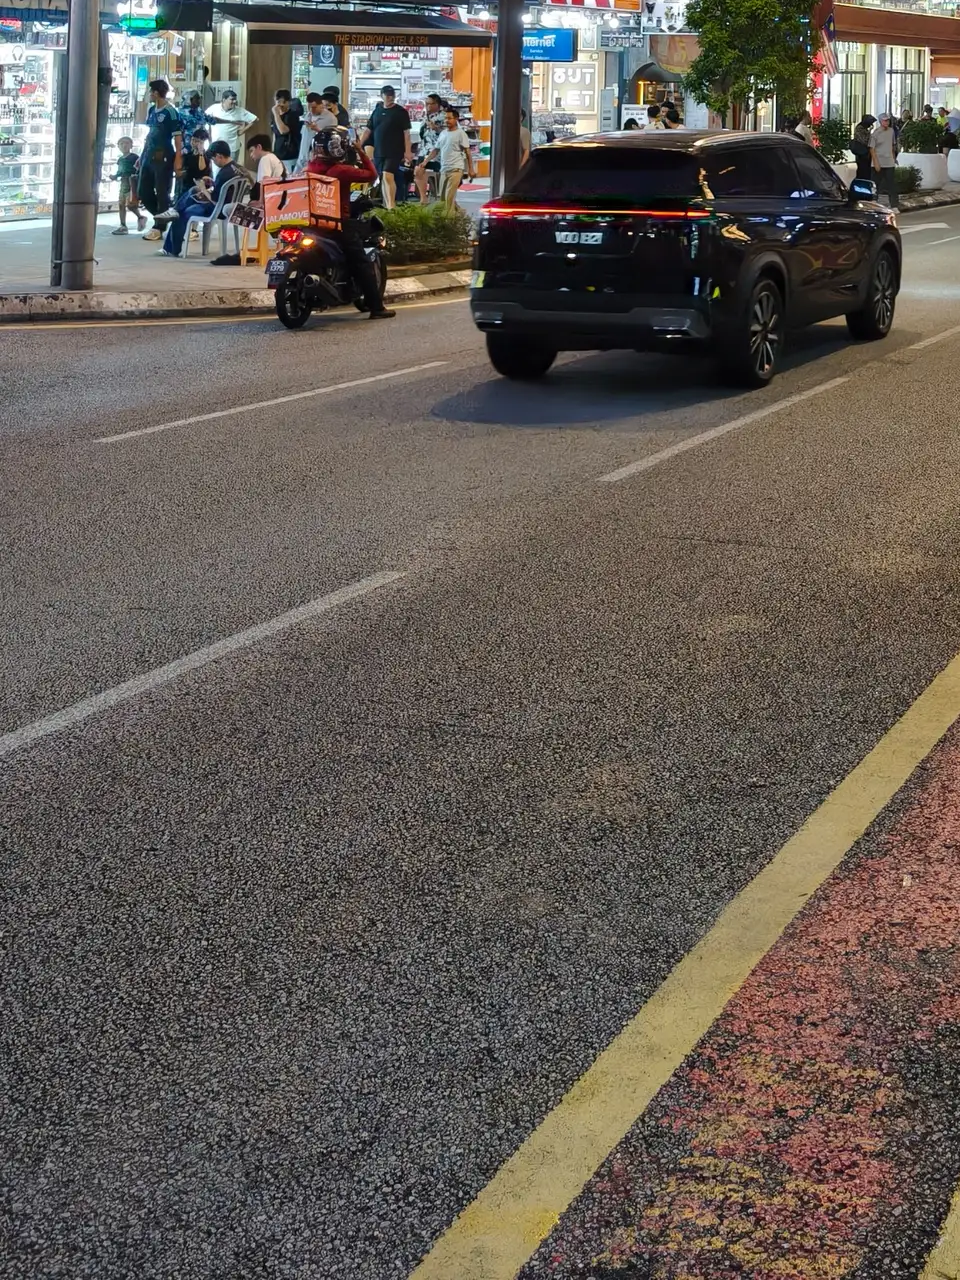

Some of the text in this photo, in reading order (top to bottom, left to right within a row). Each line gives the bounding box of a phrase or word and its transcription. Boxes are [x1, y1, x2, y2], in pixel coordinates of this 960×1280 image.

[334, 33, 350, 44] THE
[351, 34, 383, 45] STARION
[383, 34, 408, 45] HOTEL
[415, 35, 428, 45] SPA
[316, 182, 336, 197] 24/7
